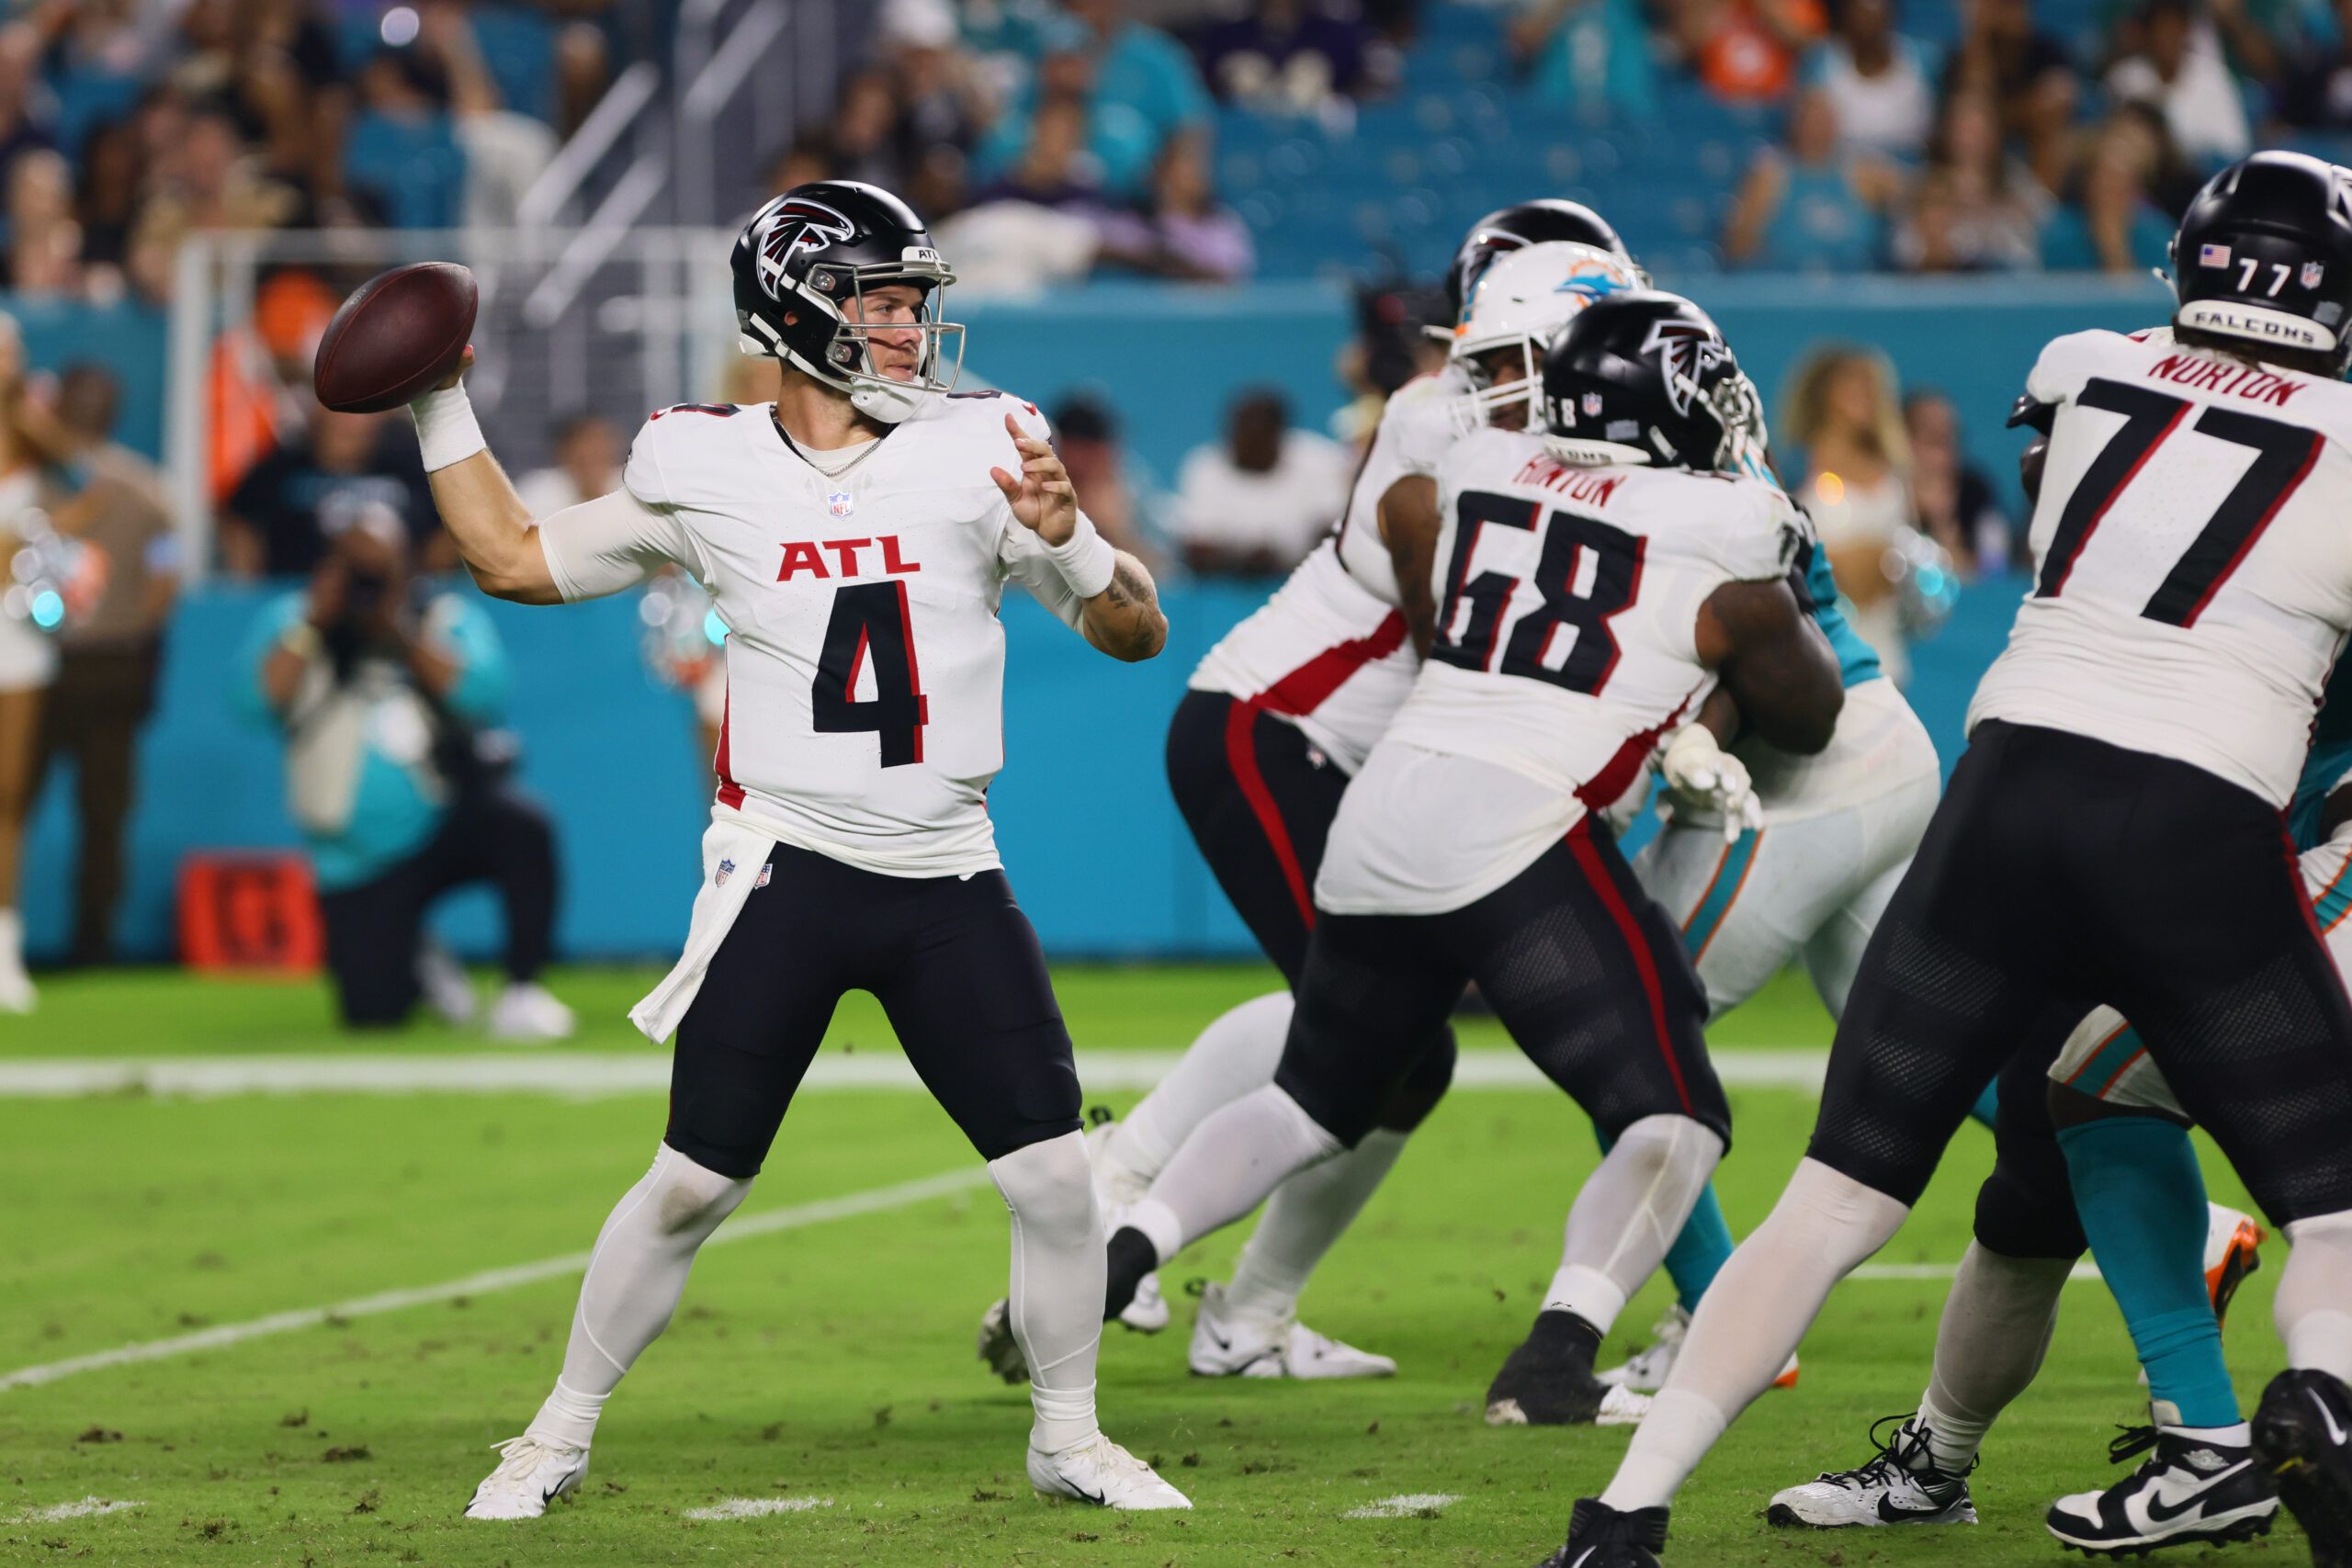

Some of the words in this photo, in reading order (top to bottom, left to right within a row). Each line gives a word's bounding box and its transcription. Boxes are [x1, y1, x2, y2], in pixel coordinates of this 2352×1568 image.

[919, 249, 938, 260] ATL
[2236, 257, 2291, 297] 77
[2195, 311, 2317, 345] FALCONS
[2148, 355, 2308, 407] NORTON
[2034, 377, 2328, 629] 77
[776, 535, 921, 582] ATL
[1429, 489, 1648, 698] 68
[811, 580, 930, 769] 4
